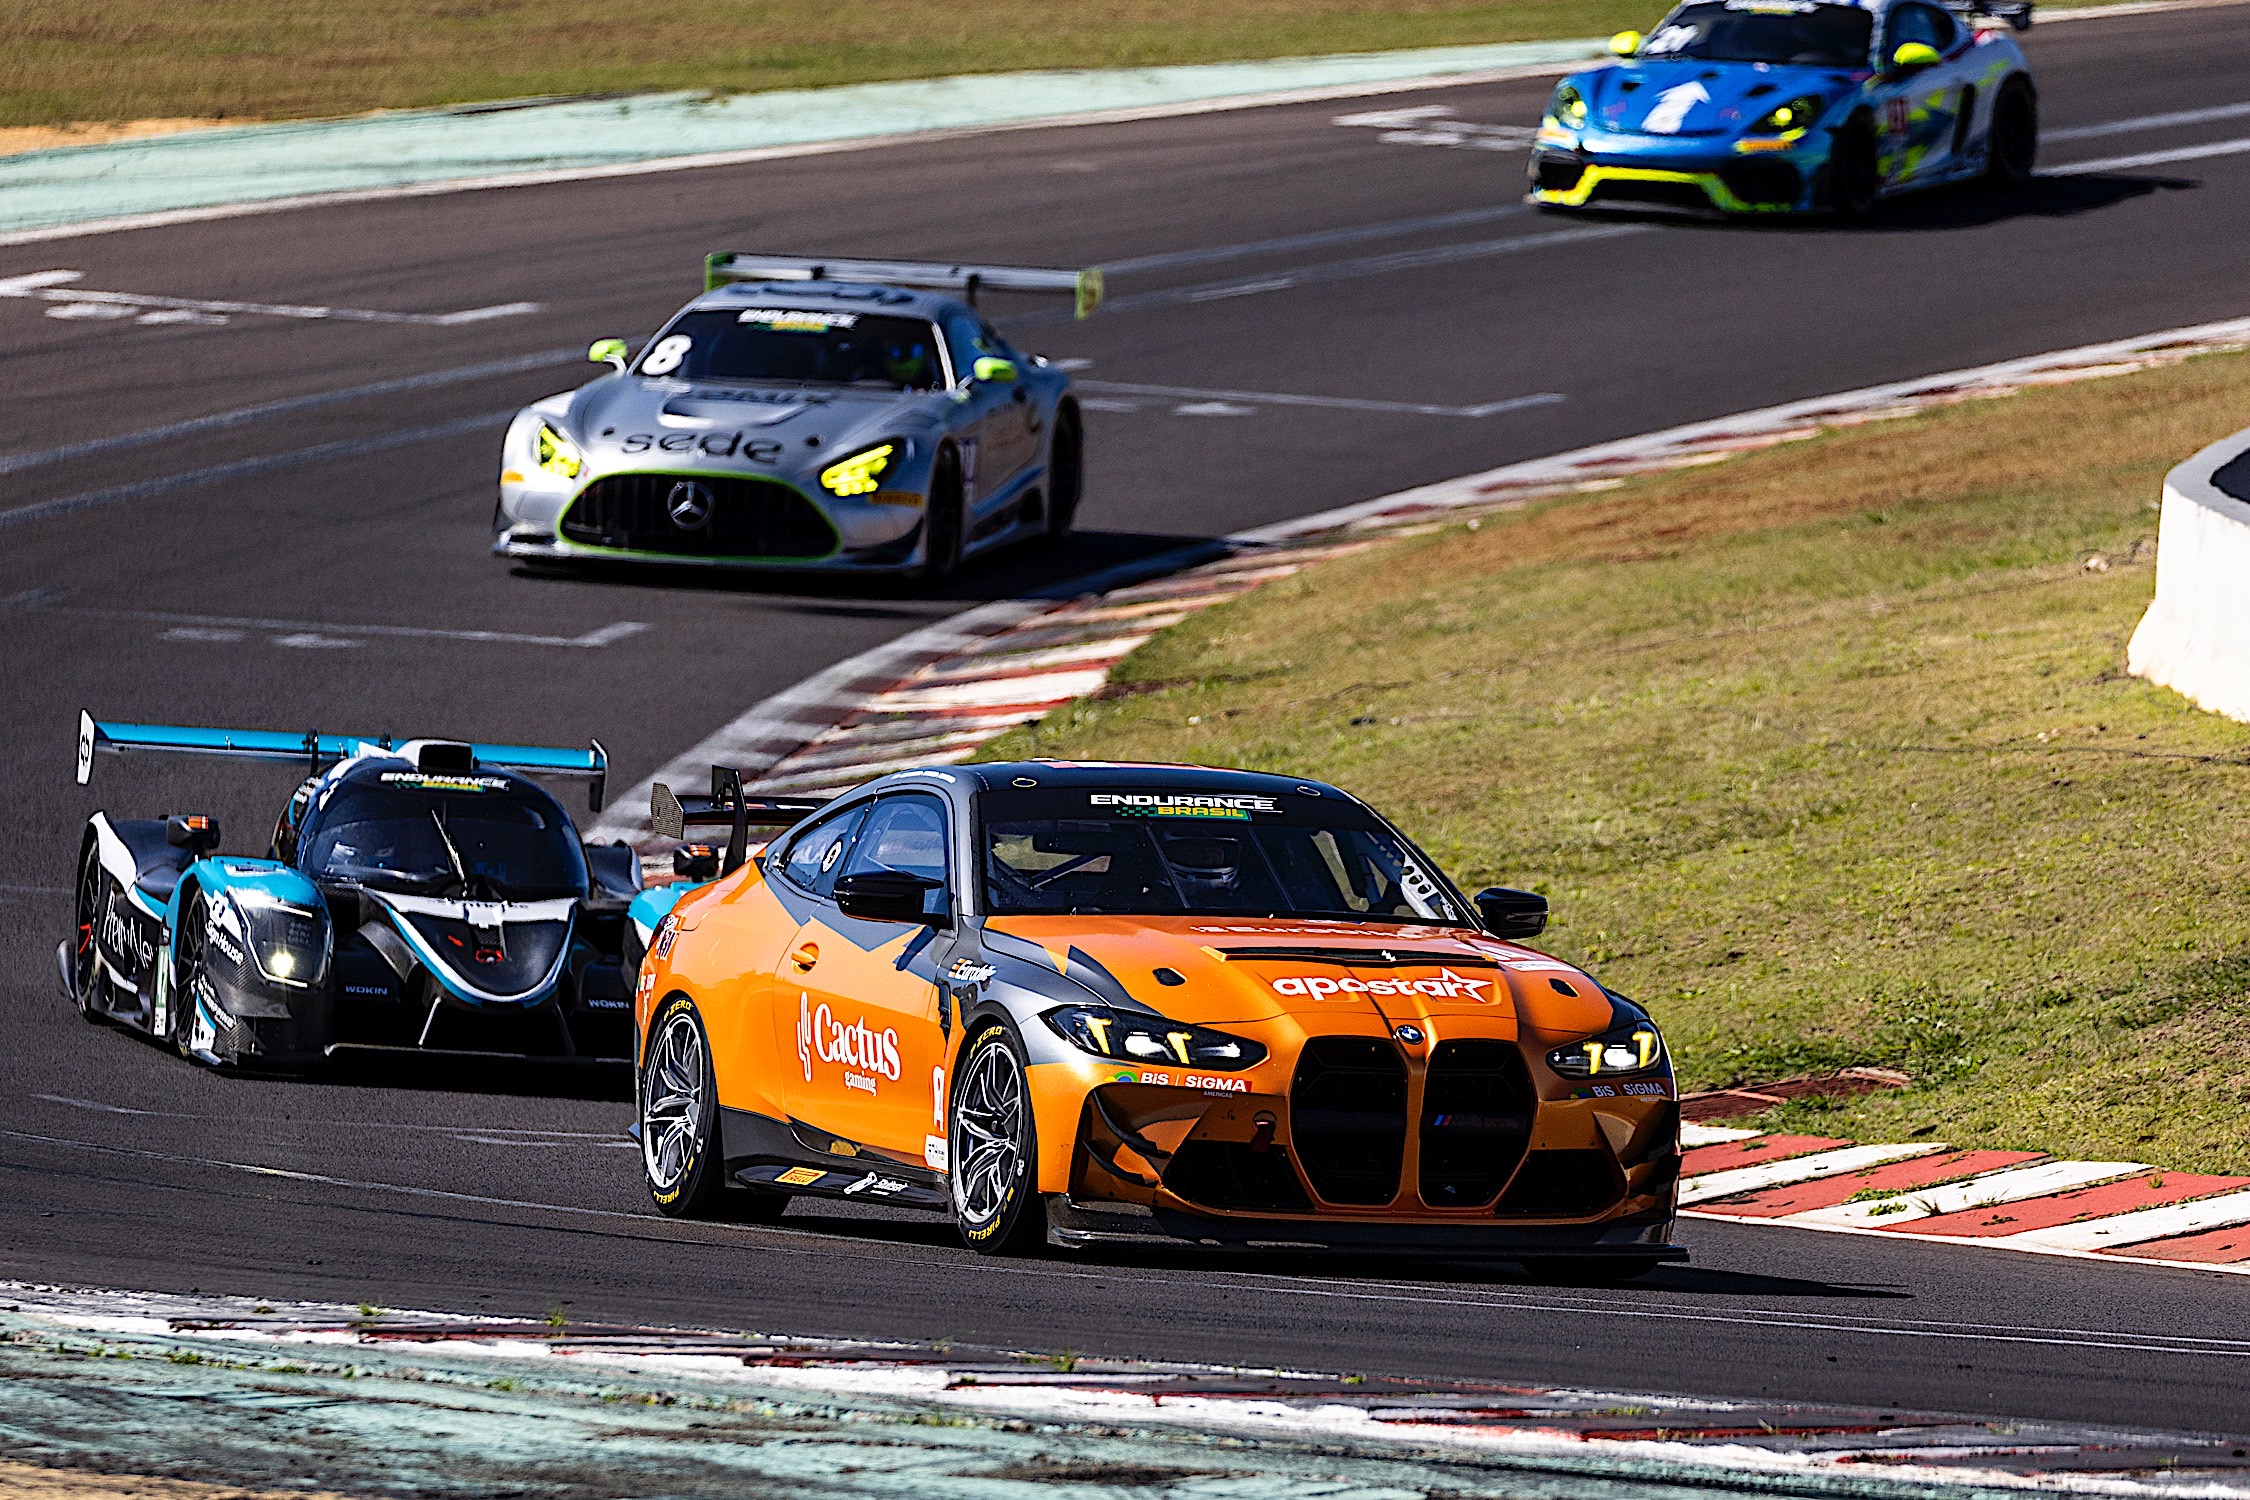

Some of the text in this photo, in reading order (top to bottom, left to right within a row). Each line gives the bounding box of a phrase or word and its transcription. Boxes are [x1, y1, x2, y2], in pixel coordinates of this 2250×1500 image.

[642, 335, 692, 375] 8
[1090, 794, 1275, 810] ENDURANCE
[1157, 806, 1244, 818] BRASIL
[345, 985, 388, 996] WOKIN
[1272, 971, 1478, 1002] apostar
[588, 999, 630, 1009] WOKIN
[669, 1000, 693, 1016] ZERO
[813, 1003, 901, 1081] Cactus
[977, 1025, 1003, 1048] ZERO
[844, 1070, 877, 1097] gaming
[1140, 1072, 1247, 1093] BiS SiGMA
[1592, 1083, 1667, 1098] BiS SiGMA
[1203, 1091, 1234, 1099] AMERICAS
[653, 1185, 680, 1205] PIRELLI
[968, 1214, 1001, 1241] PIRELLI
